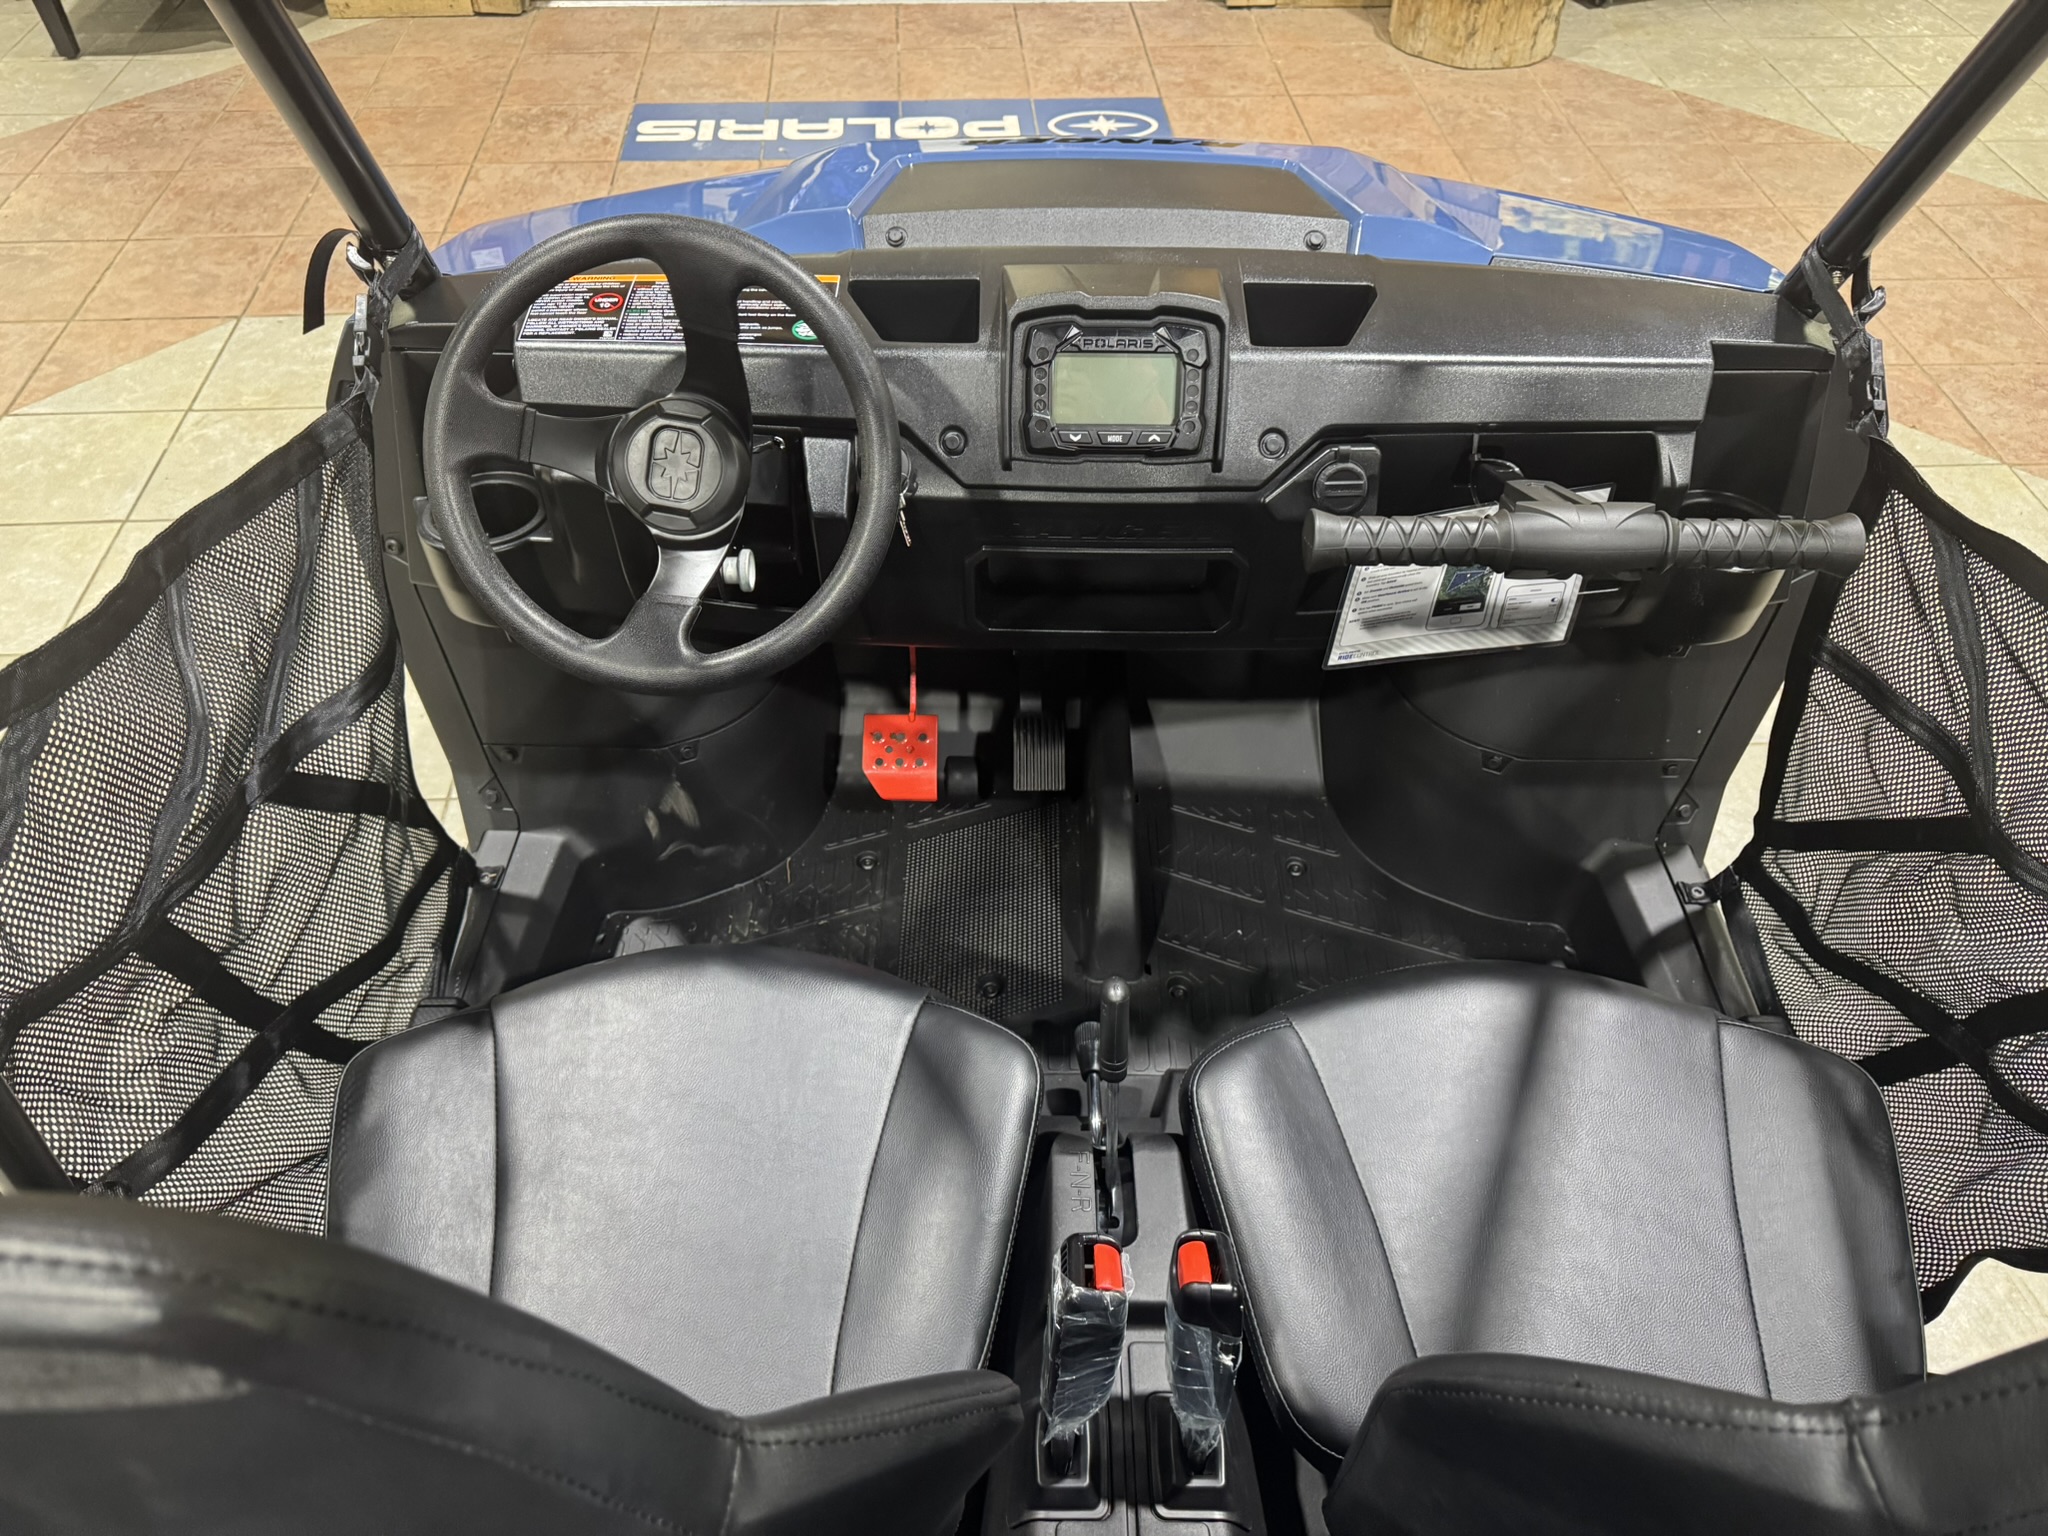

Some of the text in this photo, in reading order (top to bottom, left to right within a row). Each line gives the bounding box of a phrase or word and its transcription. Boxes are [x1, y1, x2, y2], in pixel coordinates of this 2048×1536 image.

[636, 114, 1021, 142] POLARIS
[1083, 338, 1154, 348] POLARIS
[1107, 435, 1123, 443] MODE
